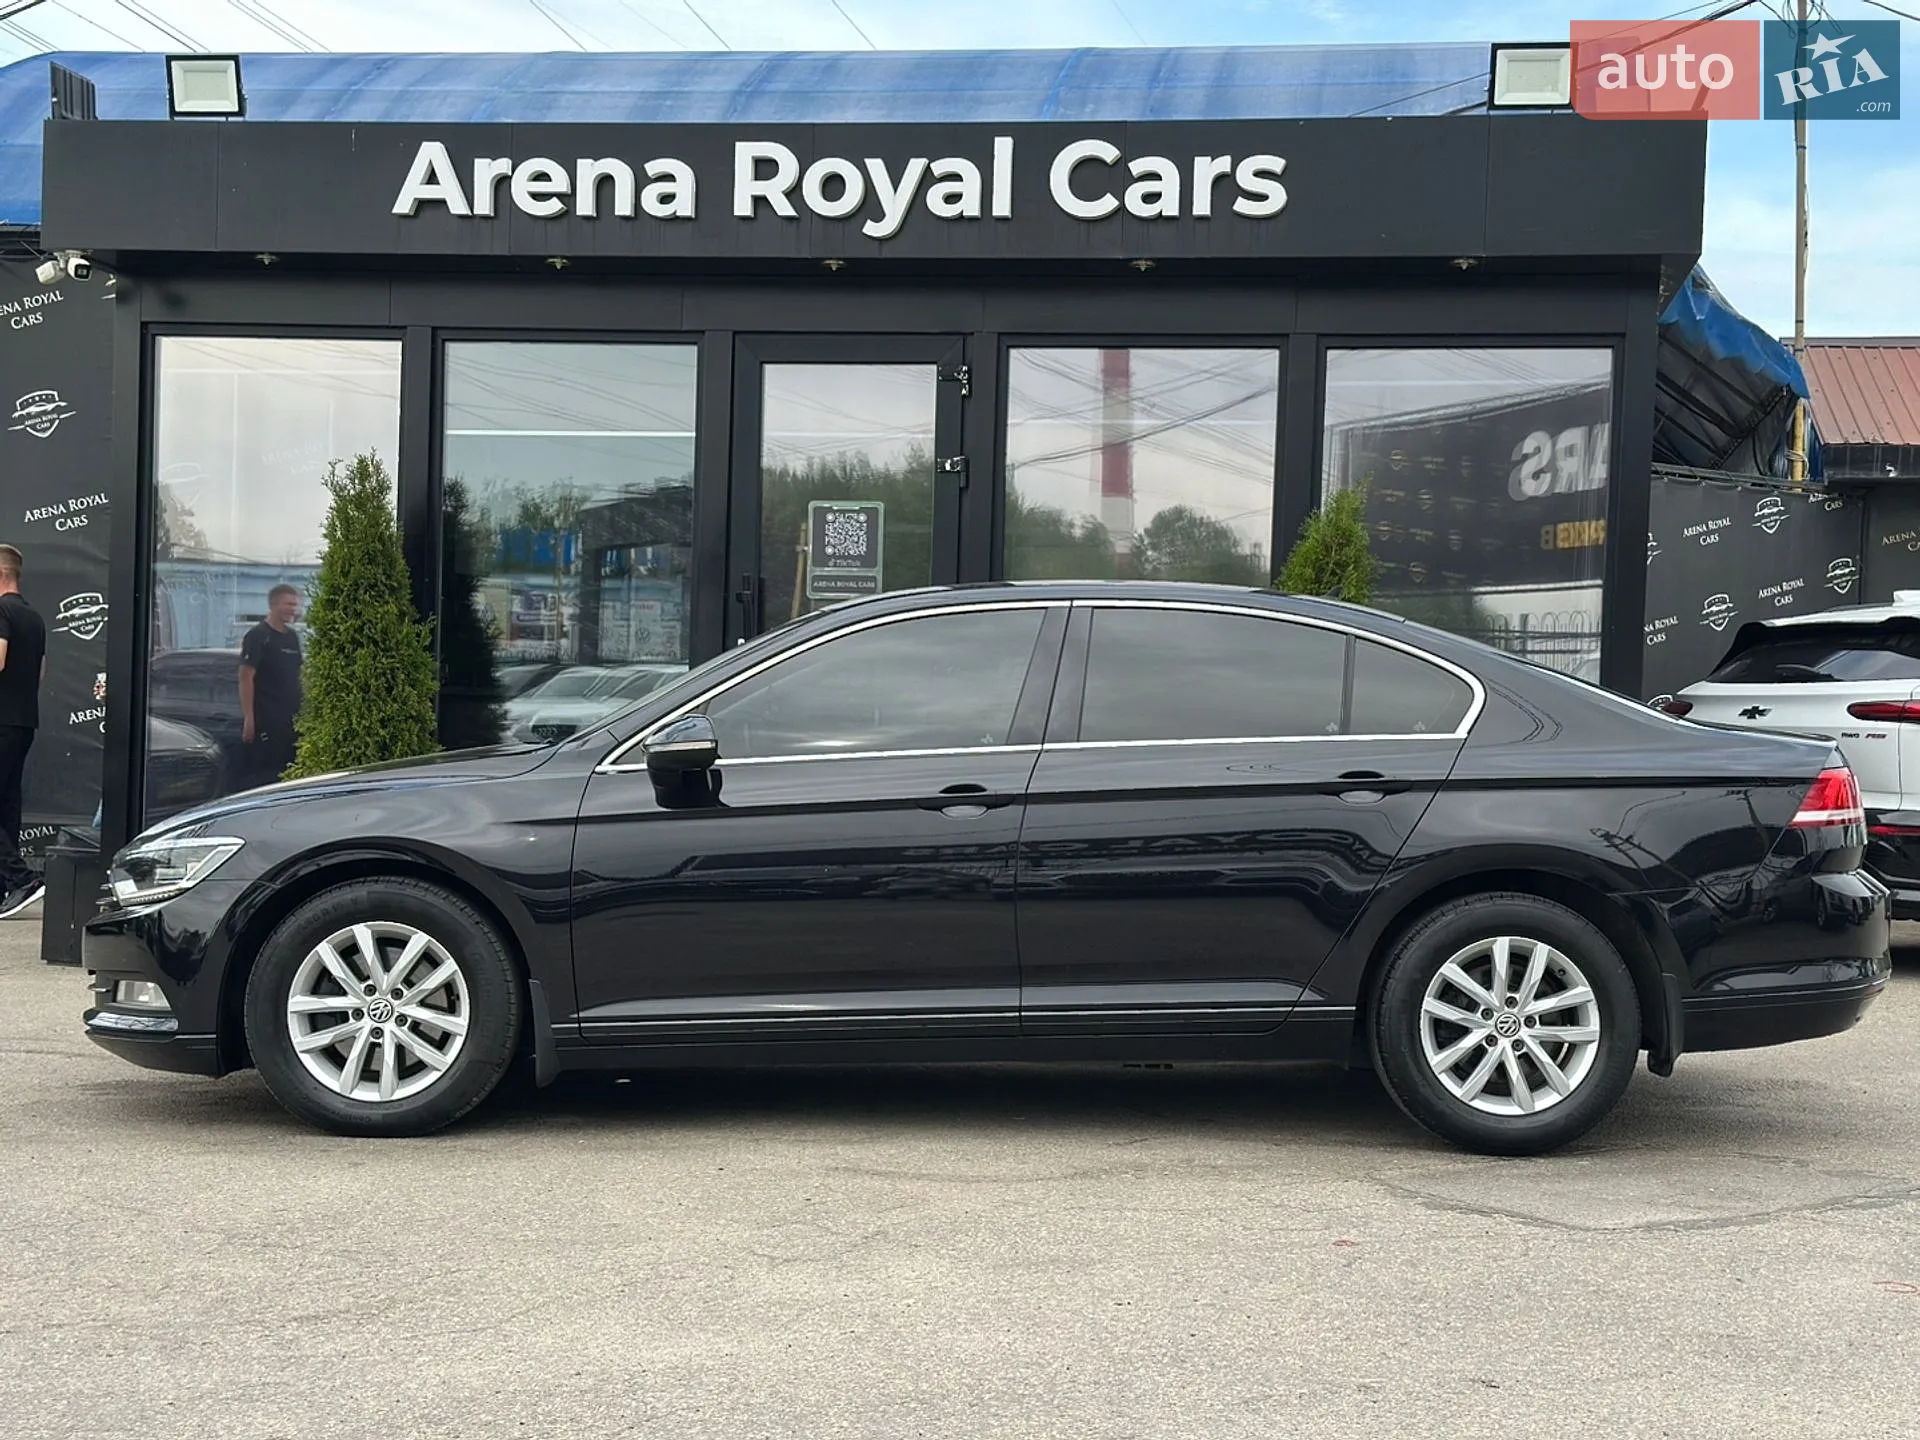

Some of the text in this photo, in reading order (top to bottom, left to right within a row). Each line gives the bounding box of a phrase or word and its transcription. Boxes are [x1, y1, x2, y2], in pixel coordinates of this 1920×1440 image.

[392, 136, 1289, 240] Arena Royal Cars
[23, 290, 64, 309] ROYAL
[11, 311, 44, 329] CARS
[24, 493, 109, 523] ARENA ROYAL
[55, 514, 88, 531] CARS
[1700, 532, 1719, 546] CARS
